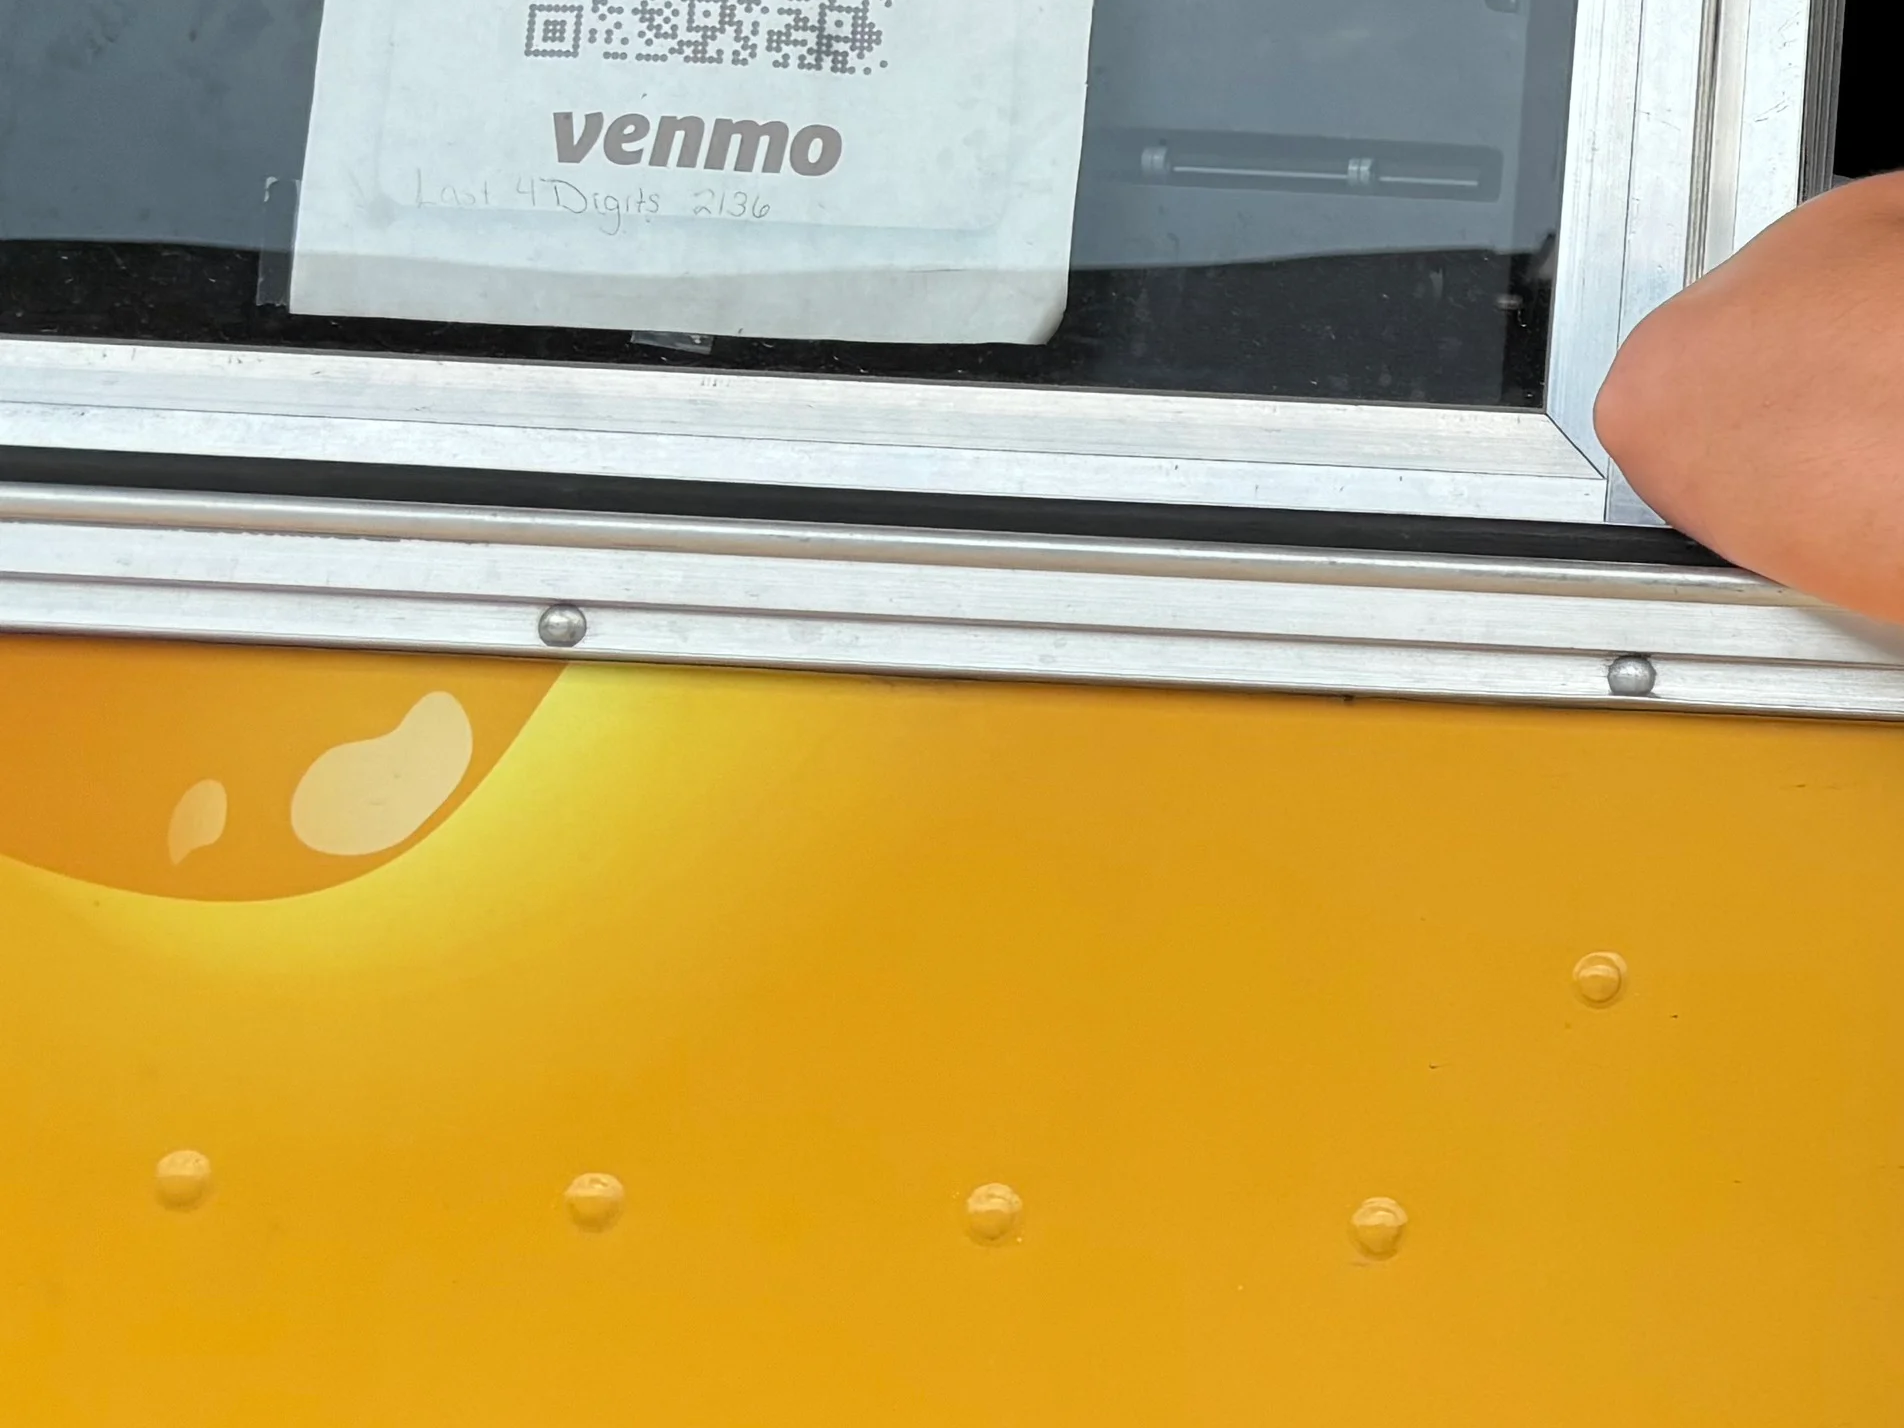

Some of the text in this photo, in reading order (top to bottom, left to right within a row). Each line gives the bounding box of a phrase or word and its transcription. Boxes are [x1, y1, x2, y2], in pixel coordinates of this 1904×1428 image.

[553, 111, 843, 177] venmo
[515, 177, 538, 206] 4
[549, 177, 661, 236] Digits
[693, 187, 771, 219] 2136
